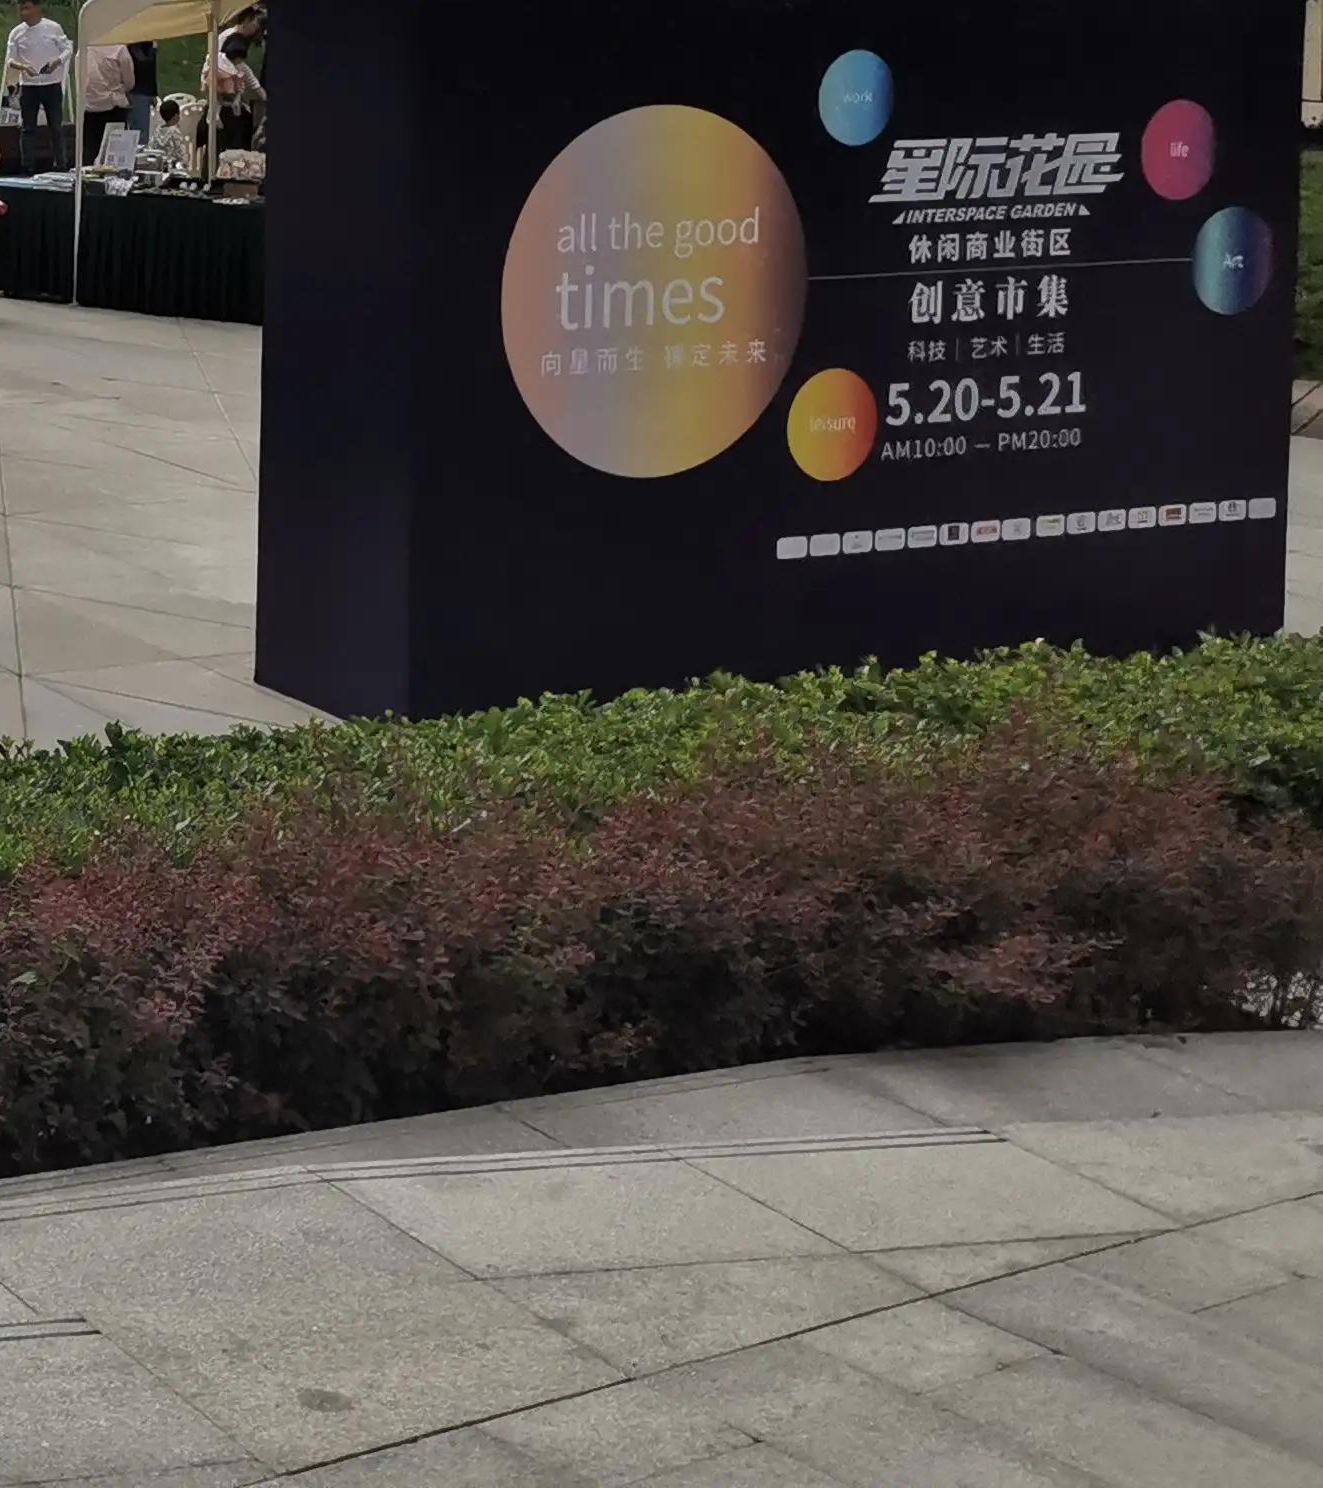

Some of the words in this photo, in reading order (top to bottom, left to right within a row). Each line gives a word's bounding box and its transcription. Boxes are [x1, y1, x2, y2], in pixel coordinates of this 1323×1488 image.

[1170, 141, 1189, 158] life
[906, 206, 1007, 224] INTERSPACE
[1010, 202, 1077, 218] GARDEN
[557, 213, 597, 253] all
[608, 212, 665, 250] the
[674, 206, 760, 259] good
[908, 228, 1072, 264] 休闲商业街区
[556, 265, 726, 331] times
[908, 274, 1070, 325] 创意市集
[540, 346, 645, 377] 向星而生
[907, 339, 947, 362] 科技
[970, 335, 1008, 359] 艺术
[1026, 332, 1065, 355] 生活
[885, 371, 1087, 427] 5.20-5.21
[880, 436, 967, 461] AM10:00
[997, 427, 1083, 451] PM20:00
